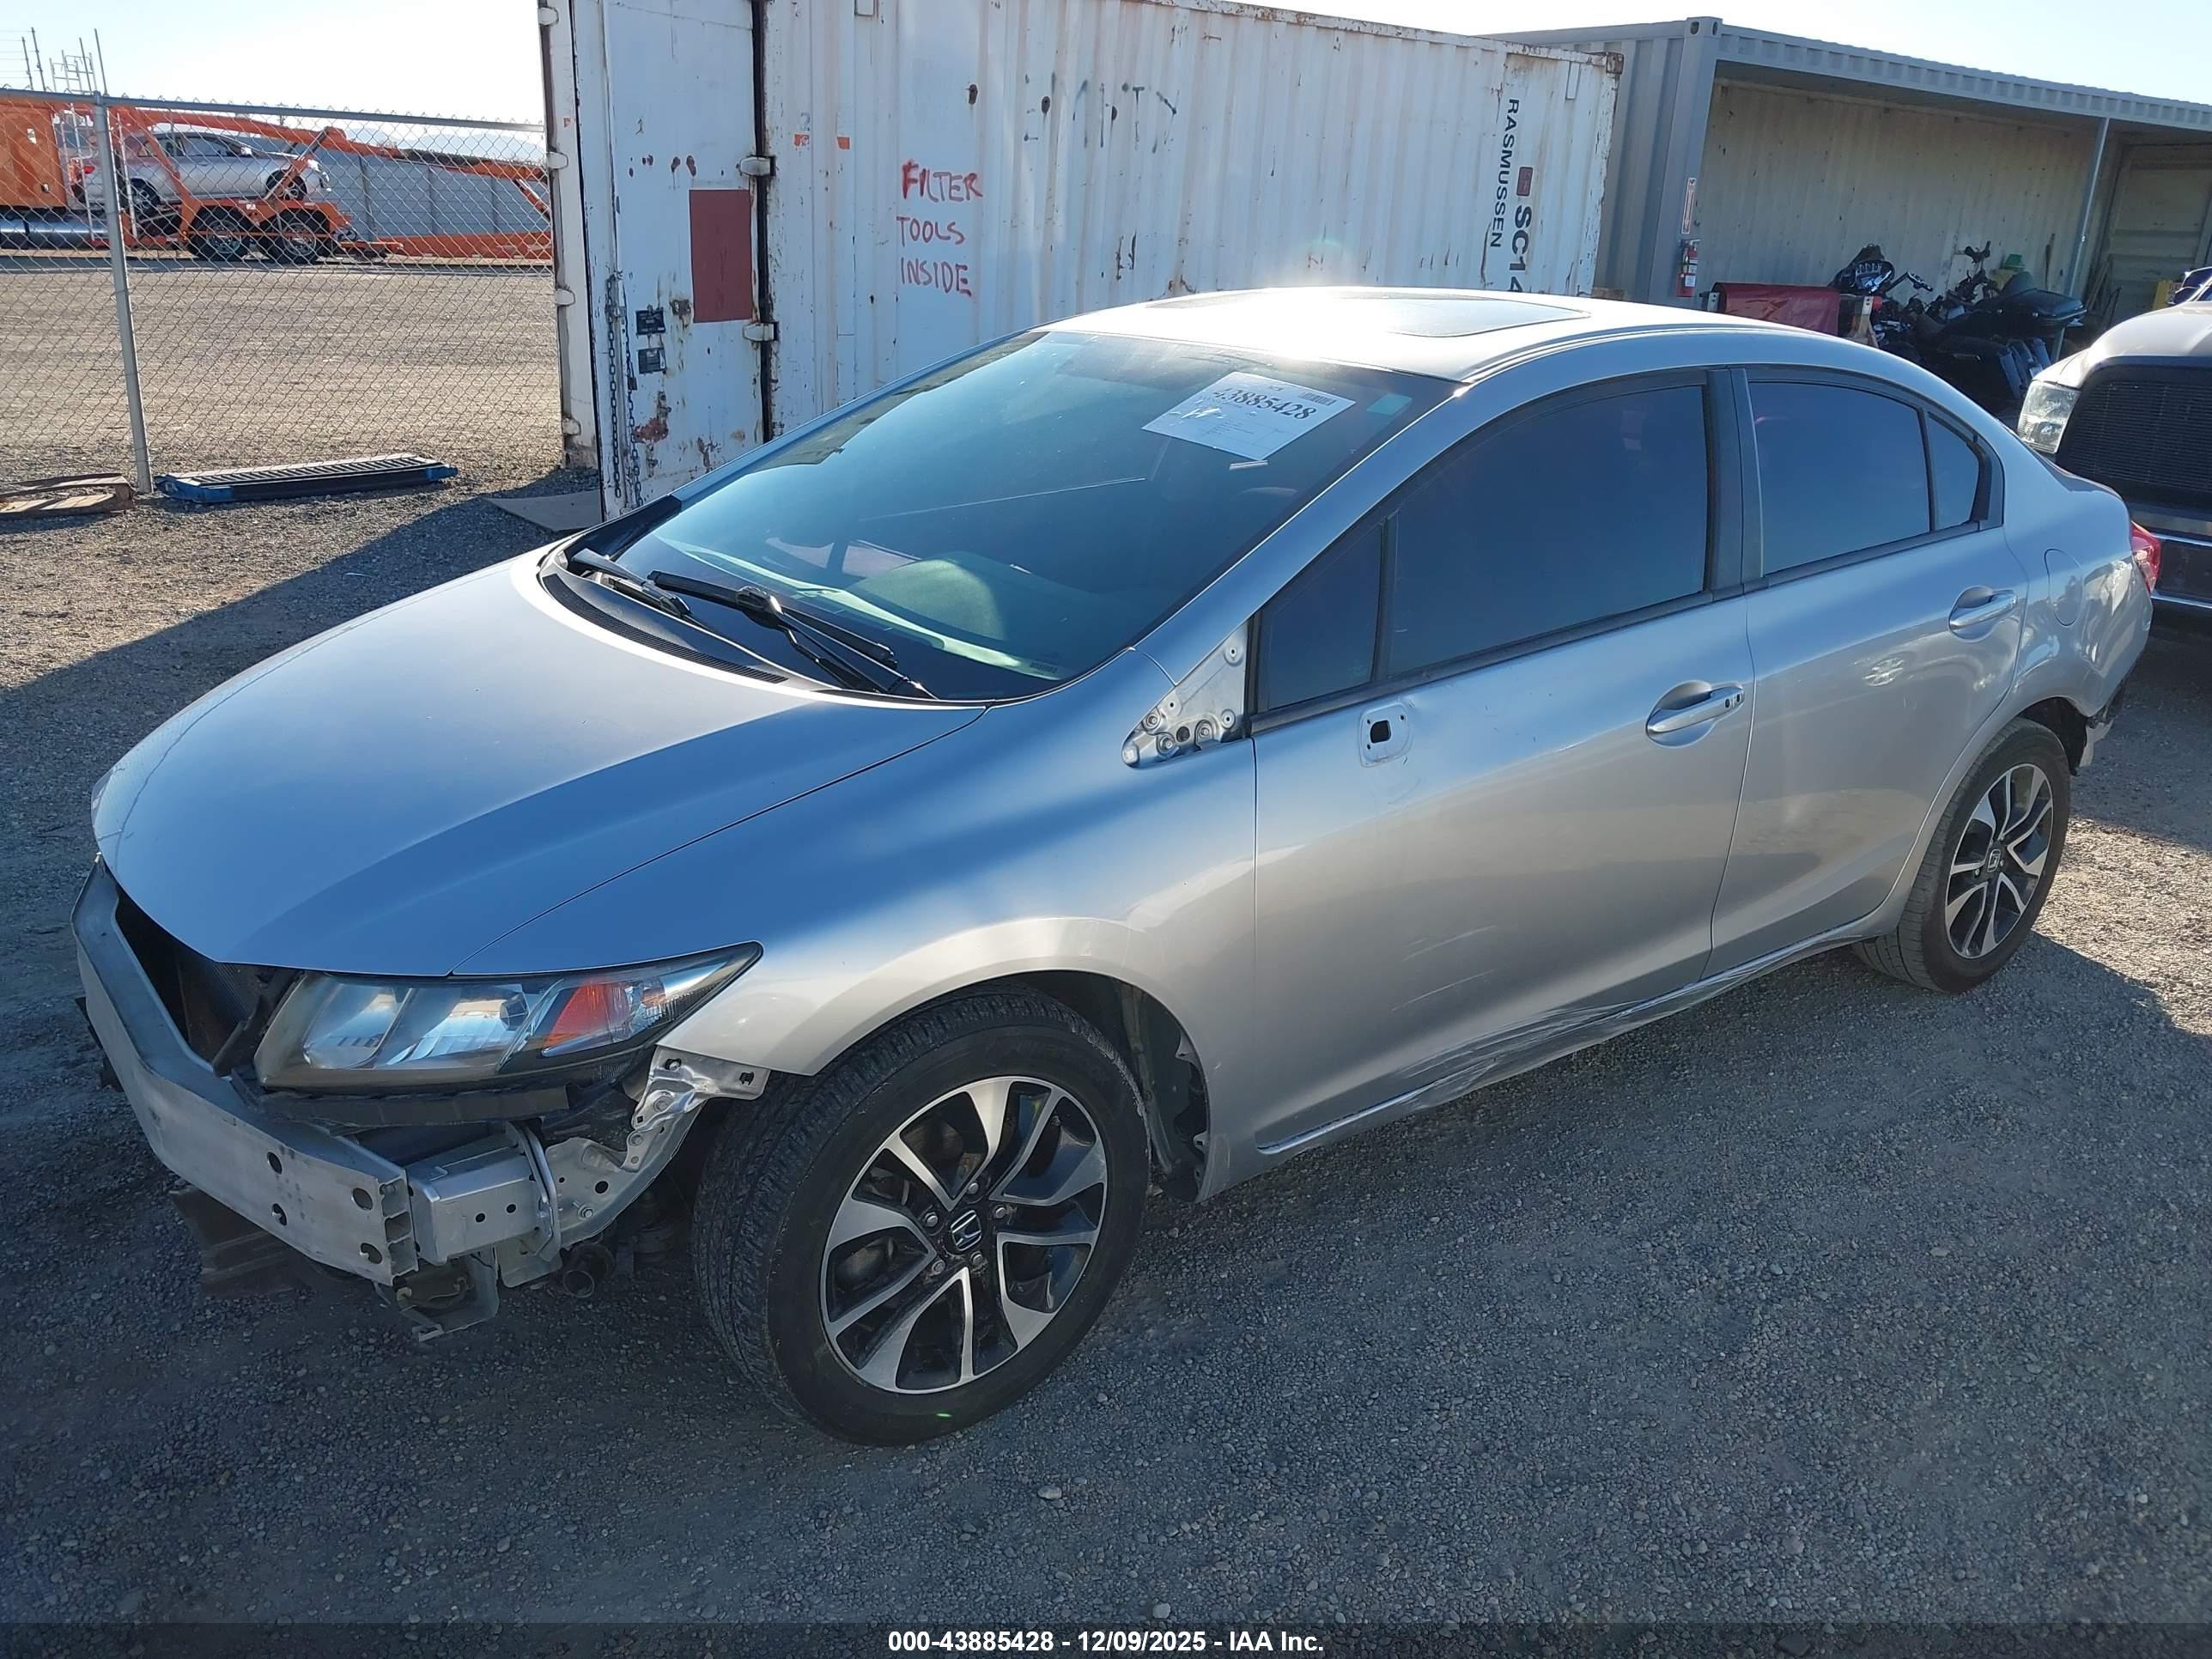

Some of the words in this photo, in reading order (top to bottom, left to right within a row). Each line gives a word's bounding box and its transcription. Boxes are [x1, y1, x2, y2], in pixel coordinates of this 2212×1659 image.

[902, 158, 983, 203] FILTER
[1490, 98, 1520, 248] RASMUSSEN
[896, 216, 967, 247] TOOLS
[901, 257, 972, 297] INSIDE
